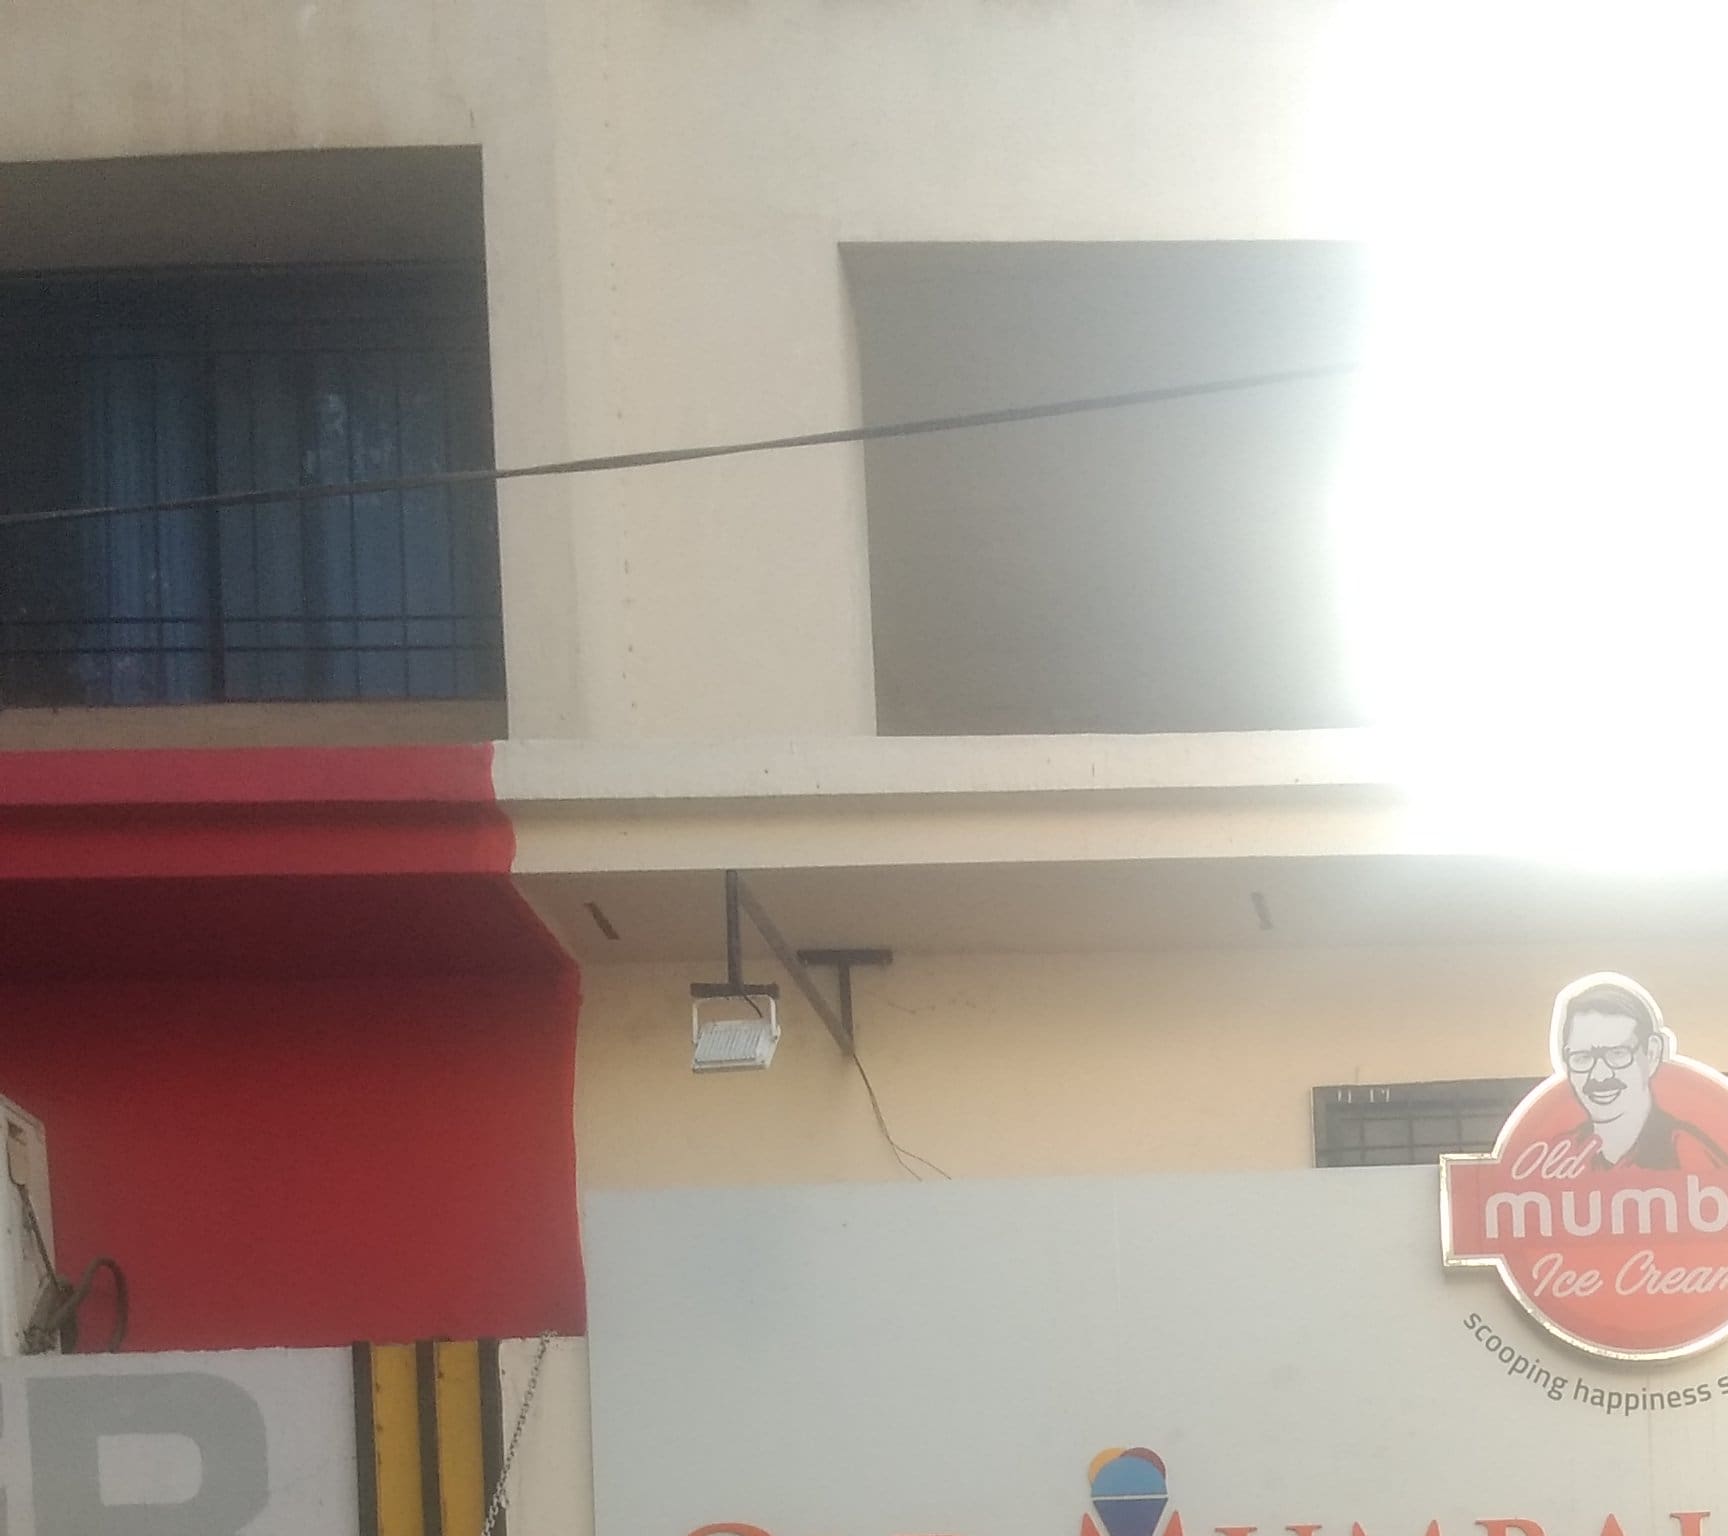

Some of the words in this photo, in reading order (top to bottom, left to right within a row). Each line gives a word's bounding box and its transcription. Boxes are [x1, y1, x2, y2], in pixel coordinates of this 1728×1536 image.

[1512, 1139, 1602, 1181] Old
[1532, 1251, 1603, 1299] Ice
[1463, 1311, 1568, 1402] scooping
[1572, 1376, 1712, 1417] happiness
